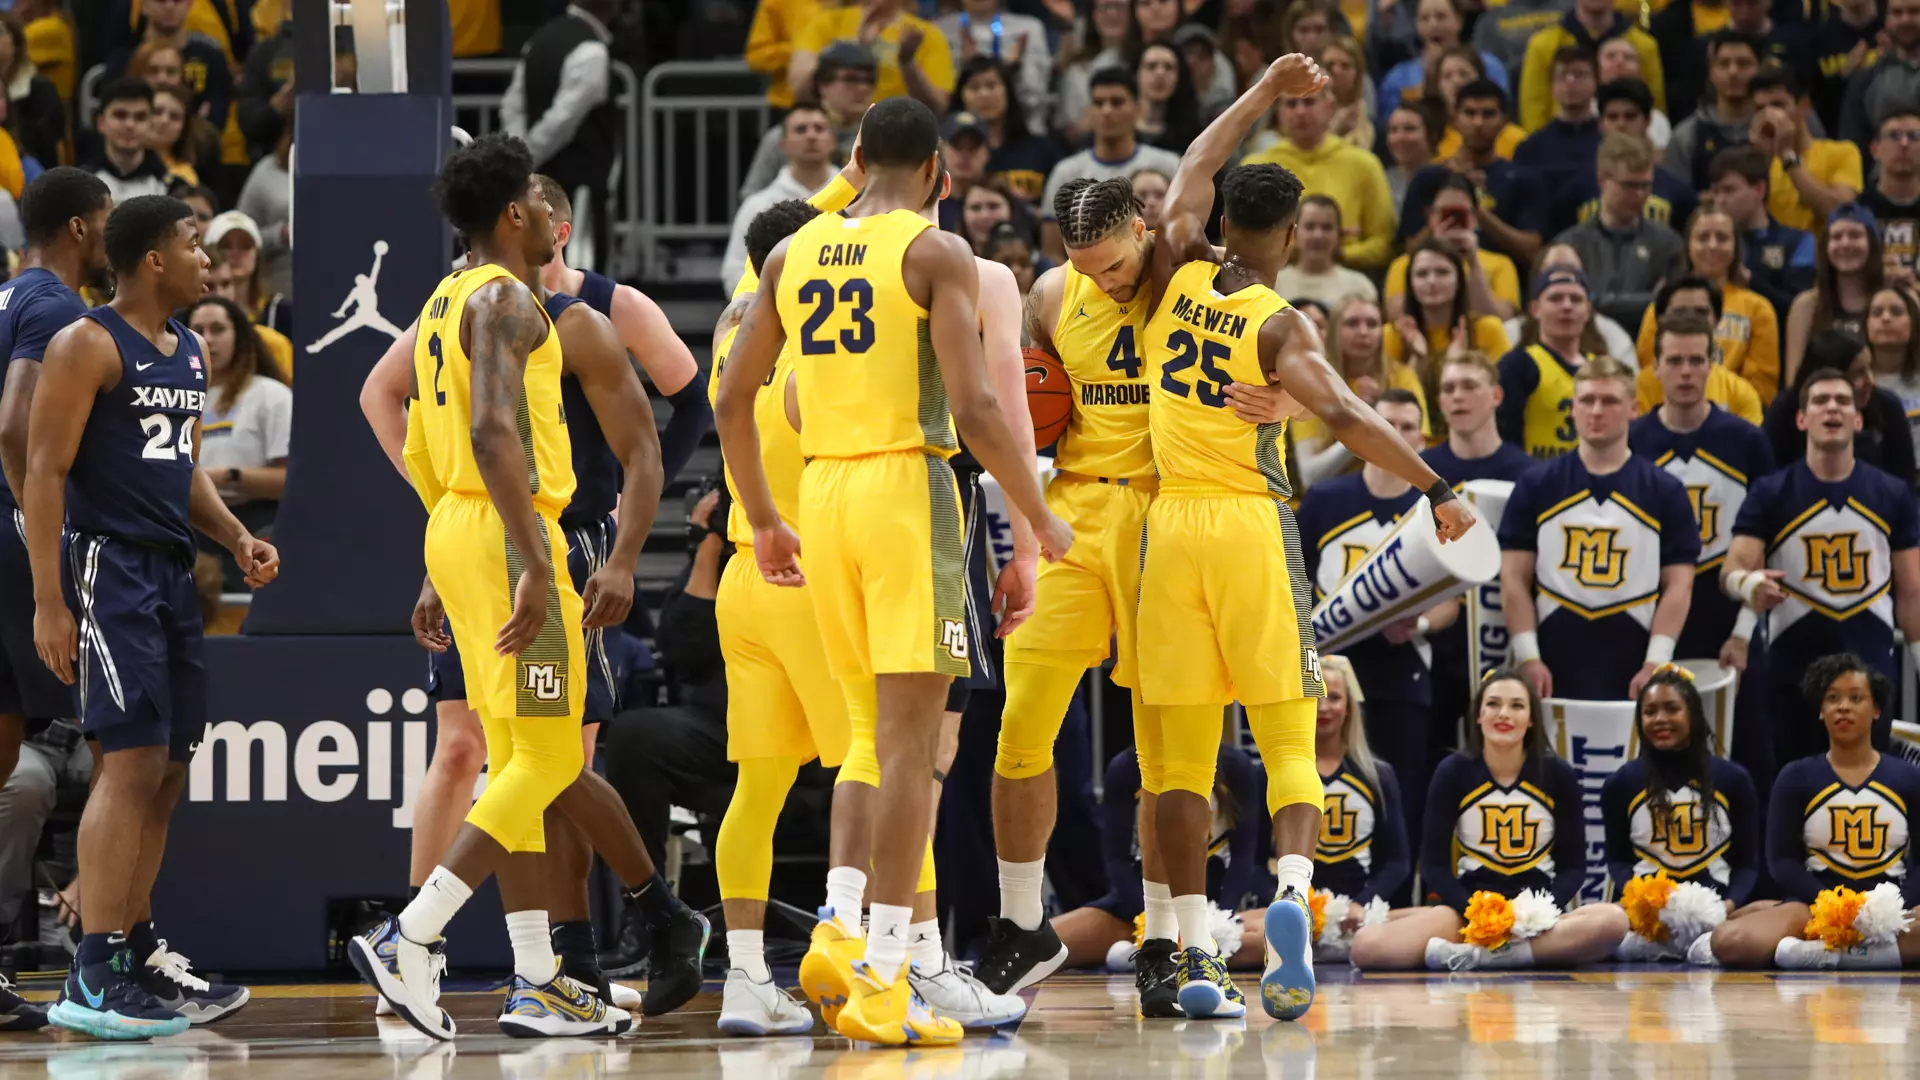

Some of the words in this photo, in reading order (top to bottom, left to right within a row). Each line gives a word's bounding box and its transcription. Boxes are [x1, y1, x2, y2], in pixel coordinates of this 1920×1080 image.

[818, 243, 868, 266] CAIN
[798, 278, 876, 356] 23
[1171, 293, 1248, 340] McEWEN
[428, 331, 447, 407] 2
[1106, 324, 1143, 379] 4
[1160, 328, 1237, 409] 25
[1081, 384, 1150, 406] MARQUE
[139, 412, 194, 464] 24
[1558, 524, 1632, 590] MU
[1801, 531, 1872, 596] MU
[1311, 594, 1354, 642] NG
[1351, 536, 1421, 613] OUT
[937, 616, 969, 663] MU
[1479, 624, 1511, 680] NG
[521, 661, 567, 703] MU
[189, 688, 429, 828] meij
[1478, 803, 1541, 860] MU
[1827, 804, 1891, 863] MU
